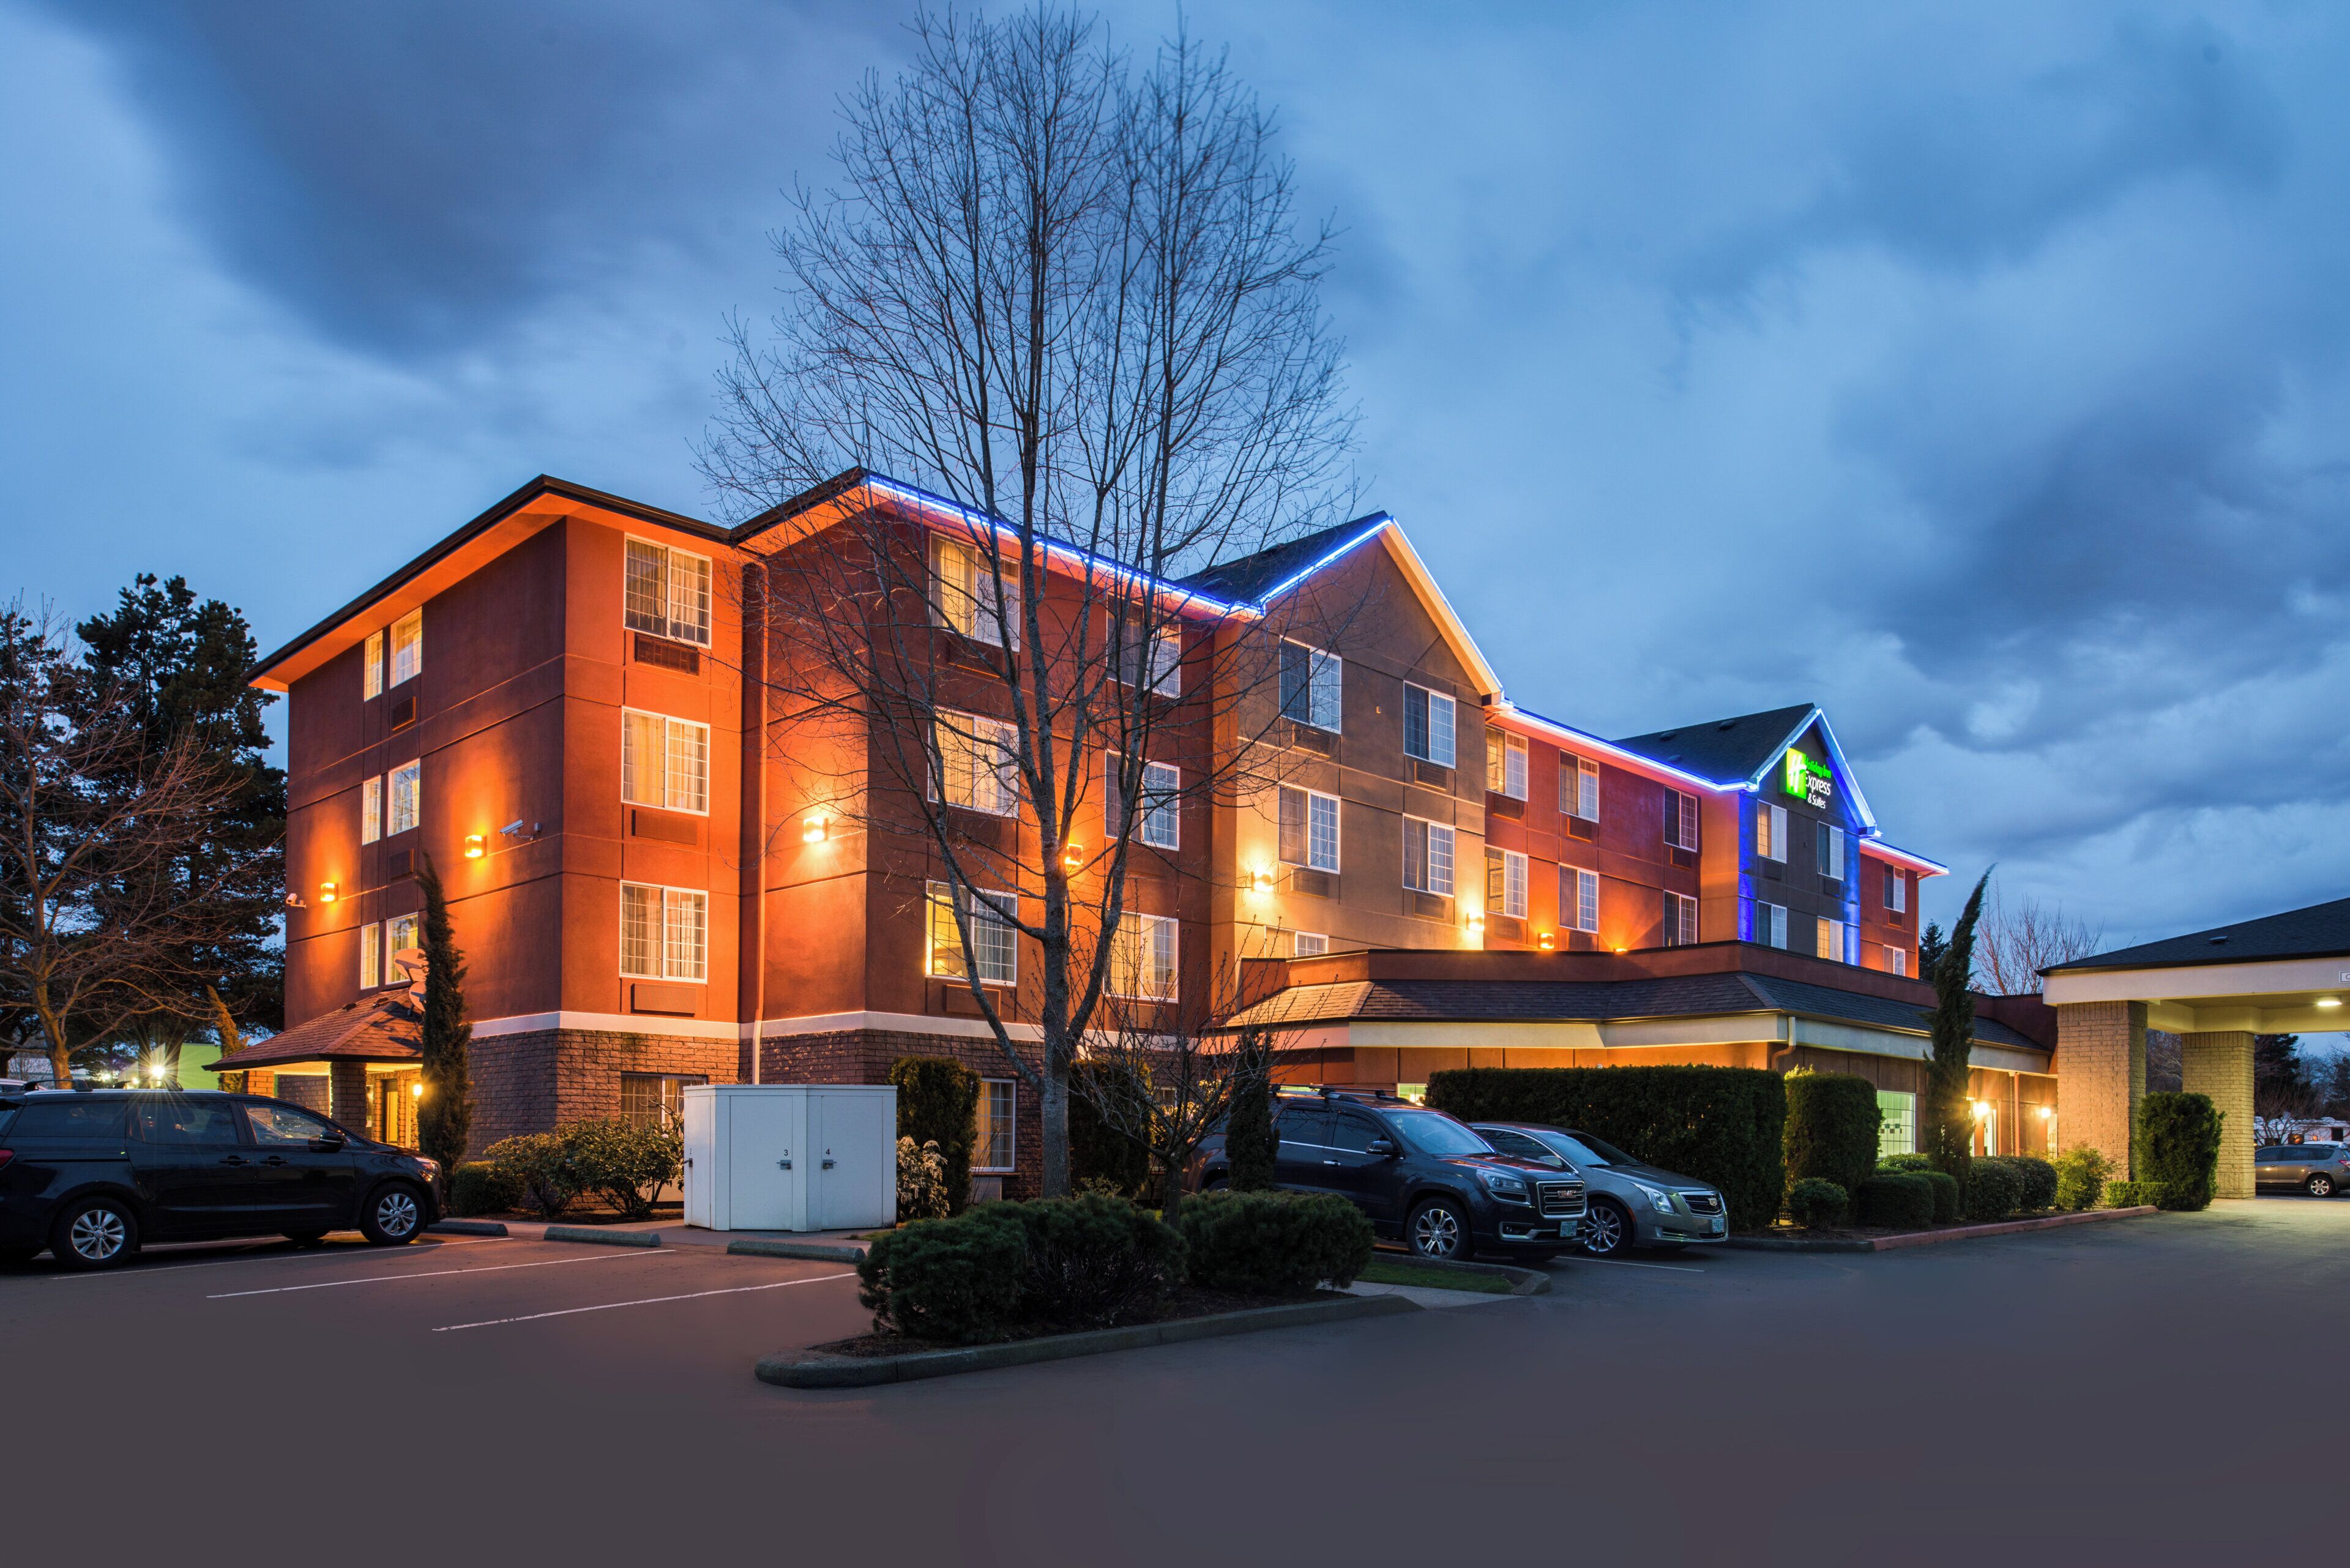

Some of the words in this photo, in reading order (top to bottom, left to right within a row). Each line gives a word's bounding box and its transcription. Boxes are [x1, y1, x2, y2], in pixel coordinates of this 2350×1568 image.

[1823, 764, 1832, 779] Inn
[1807, 793, 1812, 804] &
[1812, 794, 1826, 809] Suites
[1557, 1190, 1576, 1198] GMC
